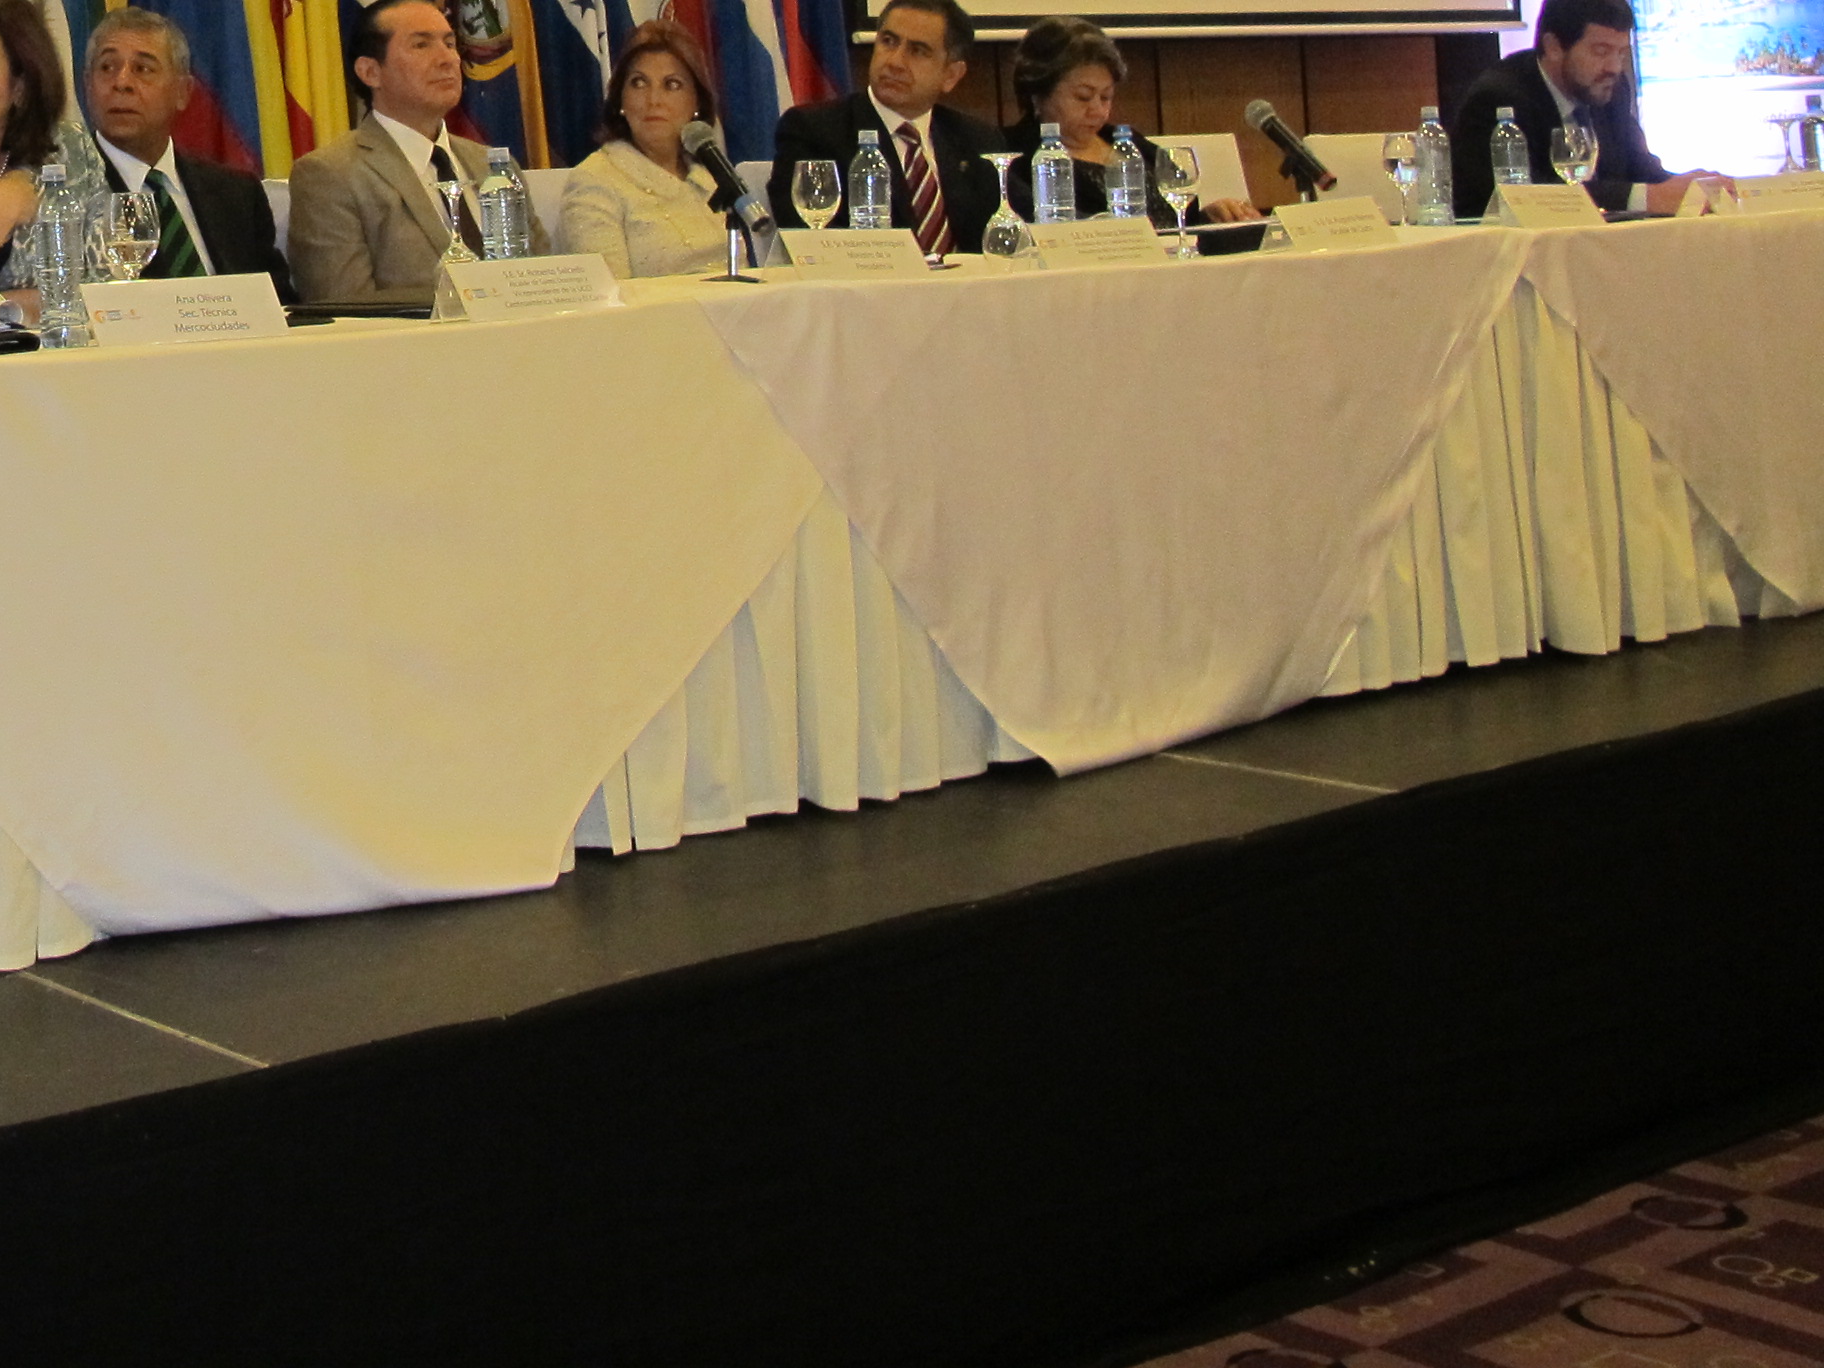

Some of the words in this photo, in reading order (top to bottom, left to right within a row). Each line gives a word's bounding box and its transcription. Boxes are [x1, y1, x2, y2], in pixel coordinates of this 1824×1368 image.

[176, 295, 195, 304] Ana
[196, 294, 232, 303] Olivera
[178, 309, 198, 318] Sec.
[200, 307, 237, 317] Técnica
[174, 321, 250, 333] Mercociudades
